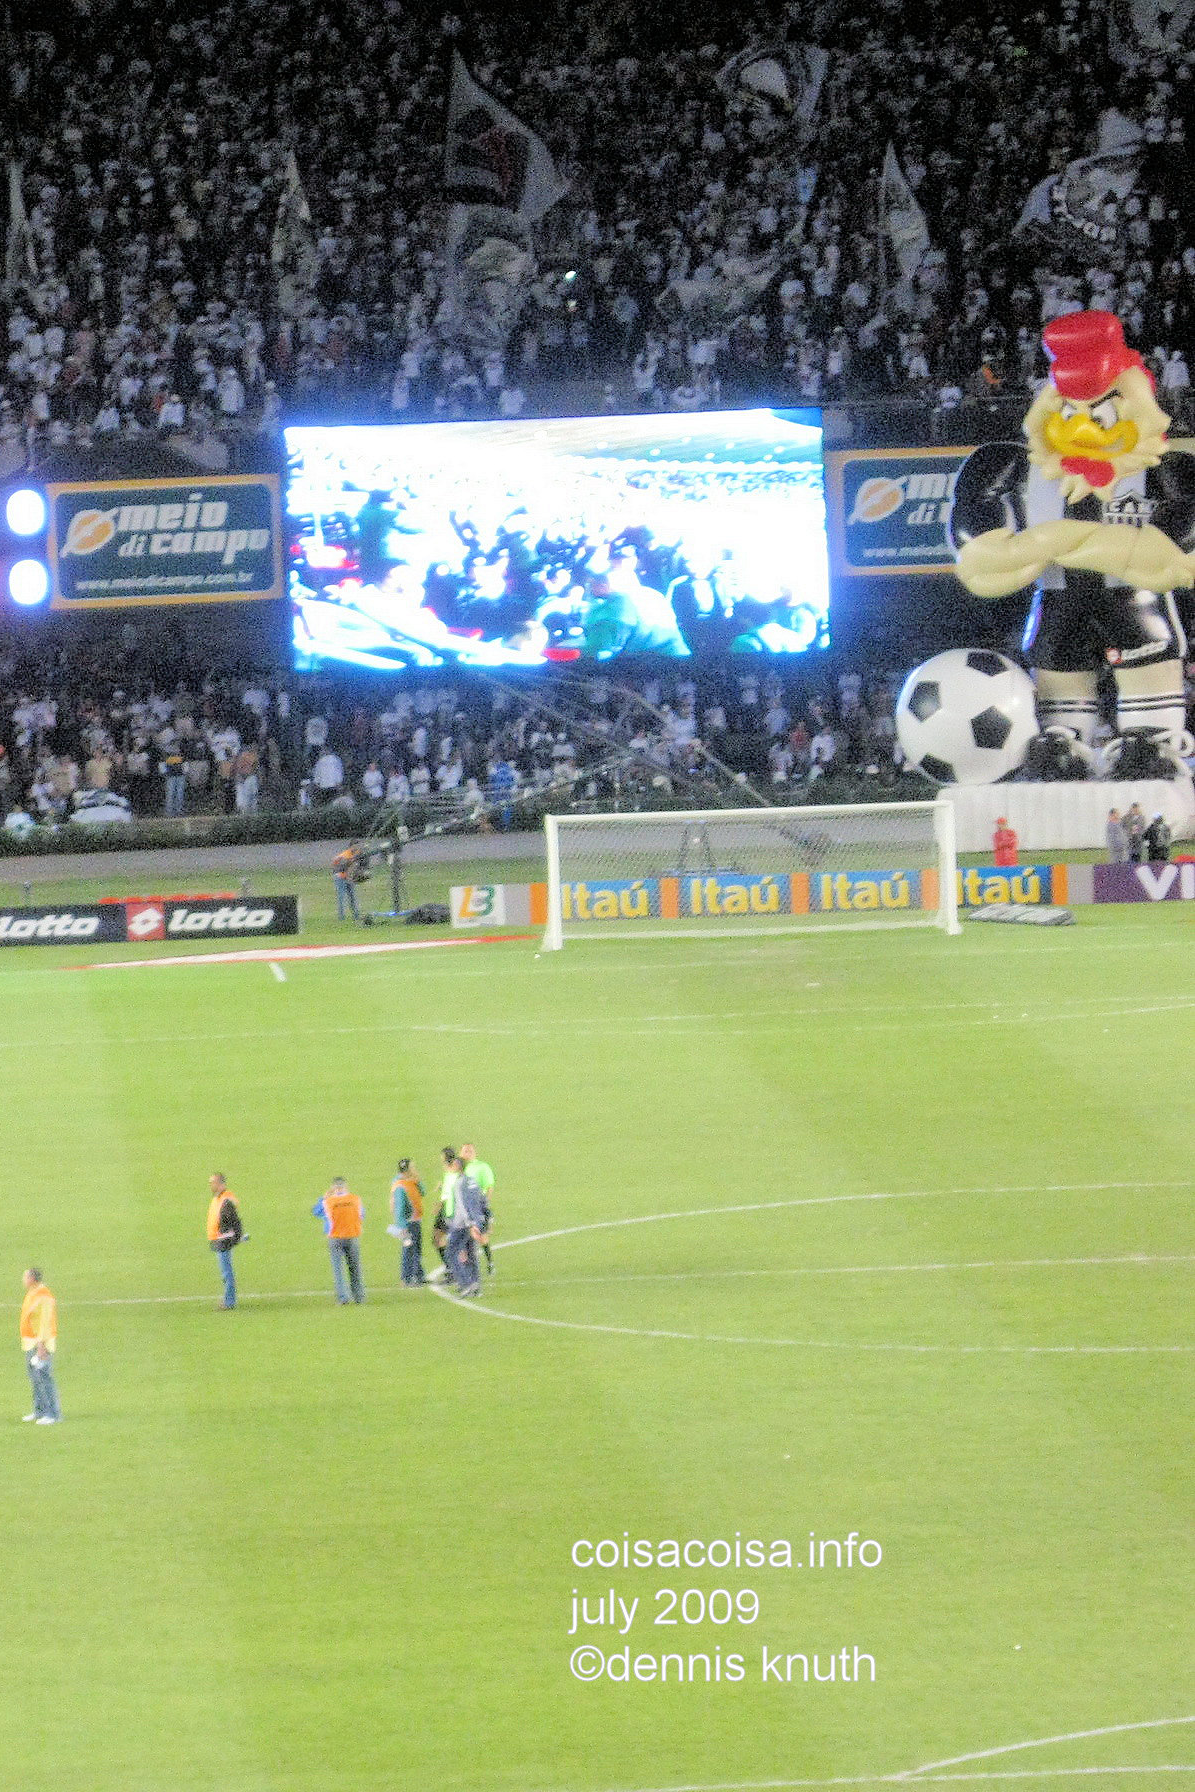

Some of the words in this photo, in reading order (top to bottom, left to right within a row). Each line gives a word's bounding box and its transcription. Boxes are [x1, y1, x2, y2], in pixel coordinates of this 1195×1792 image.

[6, 489, 45, 536] 0
[117, 493, 228, 531] meio
[118, 534, 145, 557] di
[150, 529, 270, 565] campo
[9, 559, 48, 605] 0
[562, 880, 649, 920] Itaú
[691, 876, 779, 914] Itaú
[821, 871, 909, 910] Itaú
[956, 868, 1041, 905] Itaú
[167, 907, 276, 932] lotto
